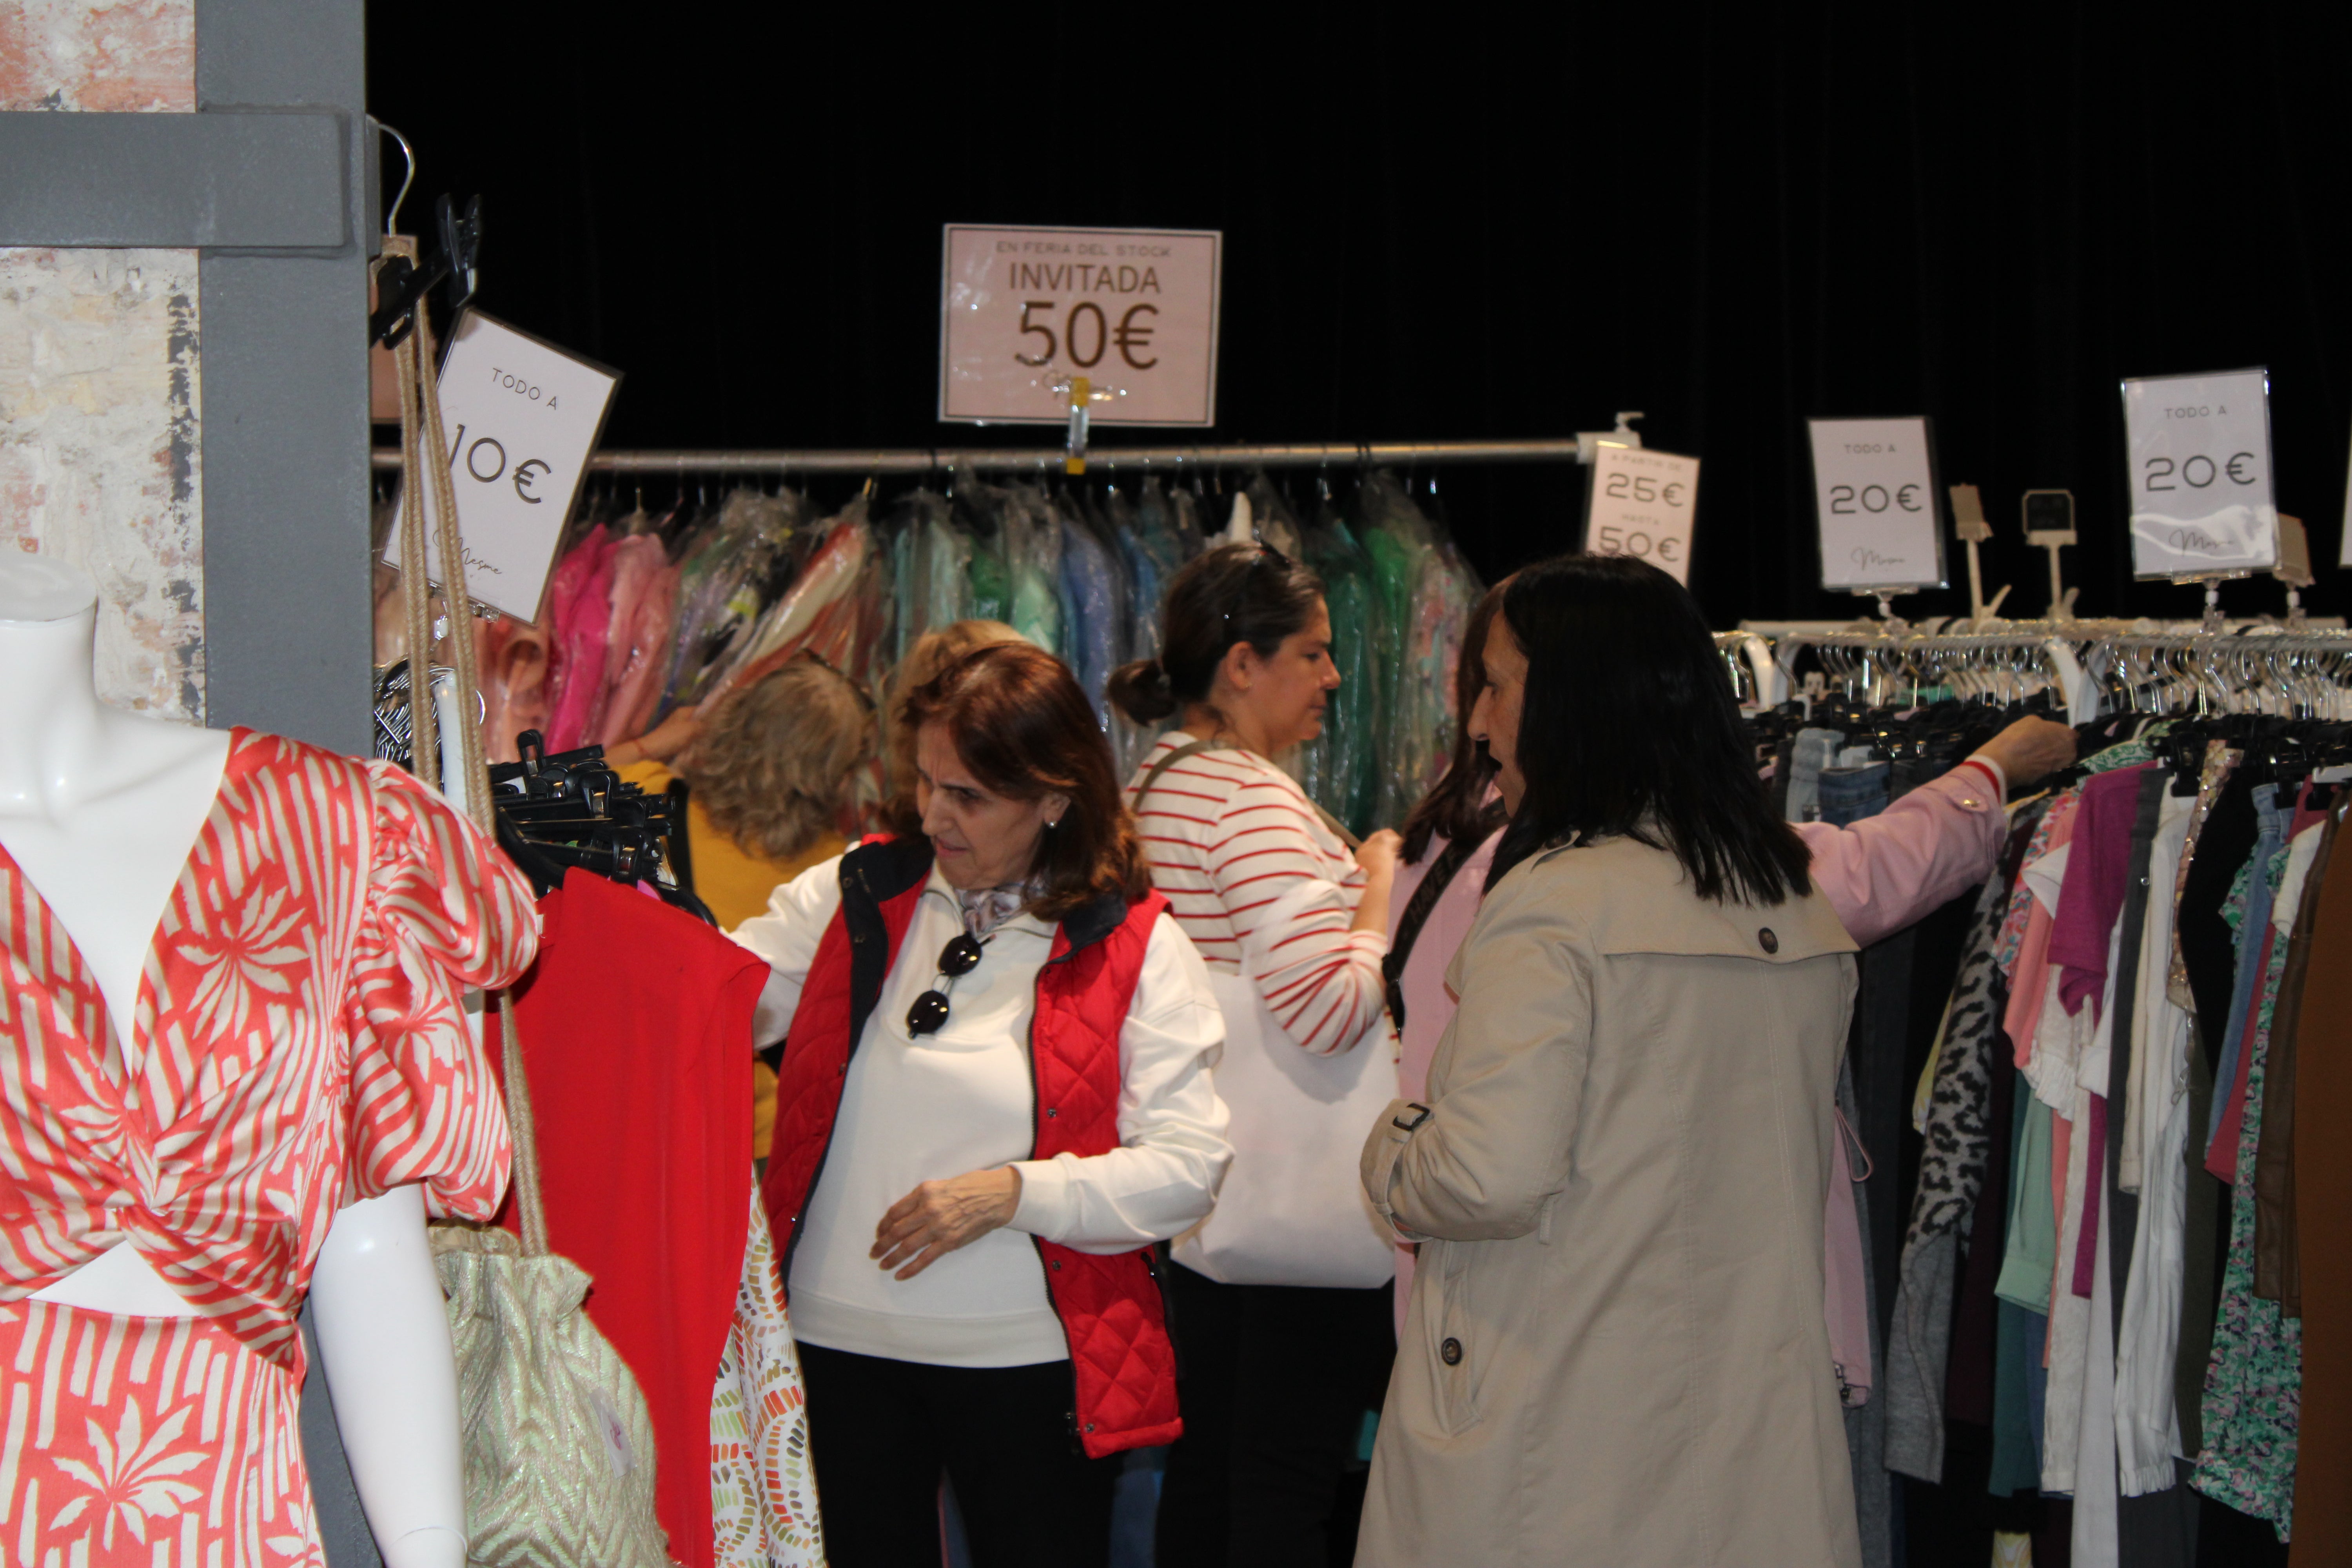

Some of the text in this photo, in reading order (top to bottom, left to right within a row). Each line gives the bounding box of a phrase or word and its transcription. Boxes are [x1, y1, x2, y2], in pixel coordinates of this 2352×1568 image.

[997, 241, 1170, 257] EN FERIA DEL STOCK
[1009, 262, 1161, 294] INVITADA
[1015, 301, 1159, 370] 50€
[492, 367, 558, 410] TODO A
[2165, 405, 2227, 419] TODO A
[449, 424, 551, 504] 10€
[1844, 444, 1896, 454] TODO A
[1606, 472, 1685, 507] 25€
[2145, 452, 2256, 492] 20€
[1830, 484, 1922, 514] 20€
[1599, 526, 1681, 562] 50€
